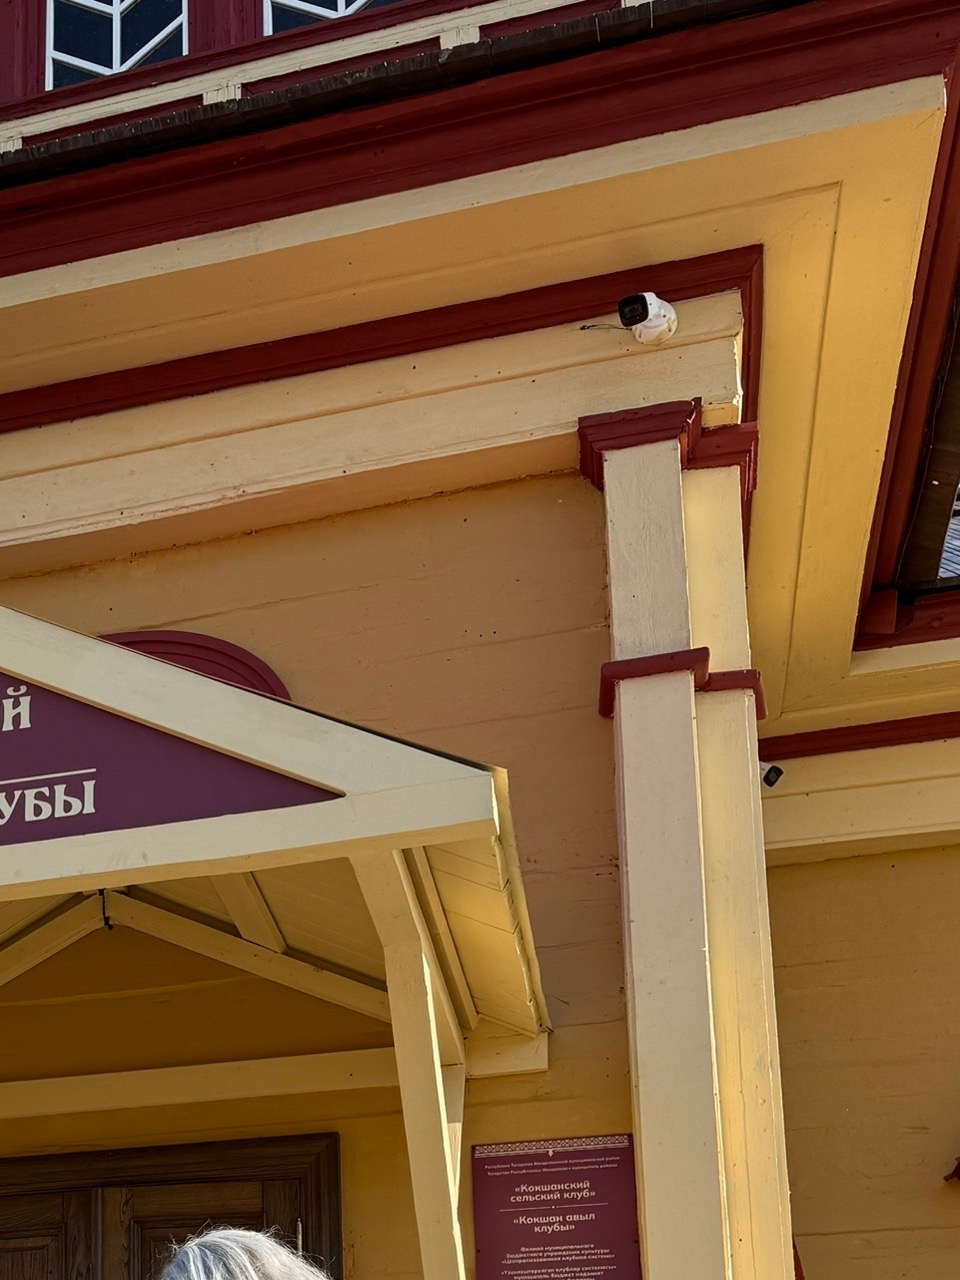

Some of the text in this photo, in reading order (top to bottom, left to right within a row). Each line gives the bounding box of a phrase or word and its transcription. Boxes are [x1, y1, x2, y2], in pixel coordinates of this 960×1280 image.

[515, 1180, 590, 1193] «Кокшанский
[510, 1189, 596, 1202] сельский клуб»
[513, 1213, 595, 1225] «Кокшан авыл
[534, 1223, 575, 1234] клубы»
